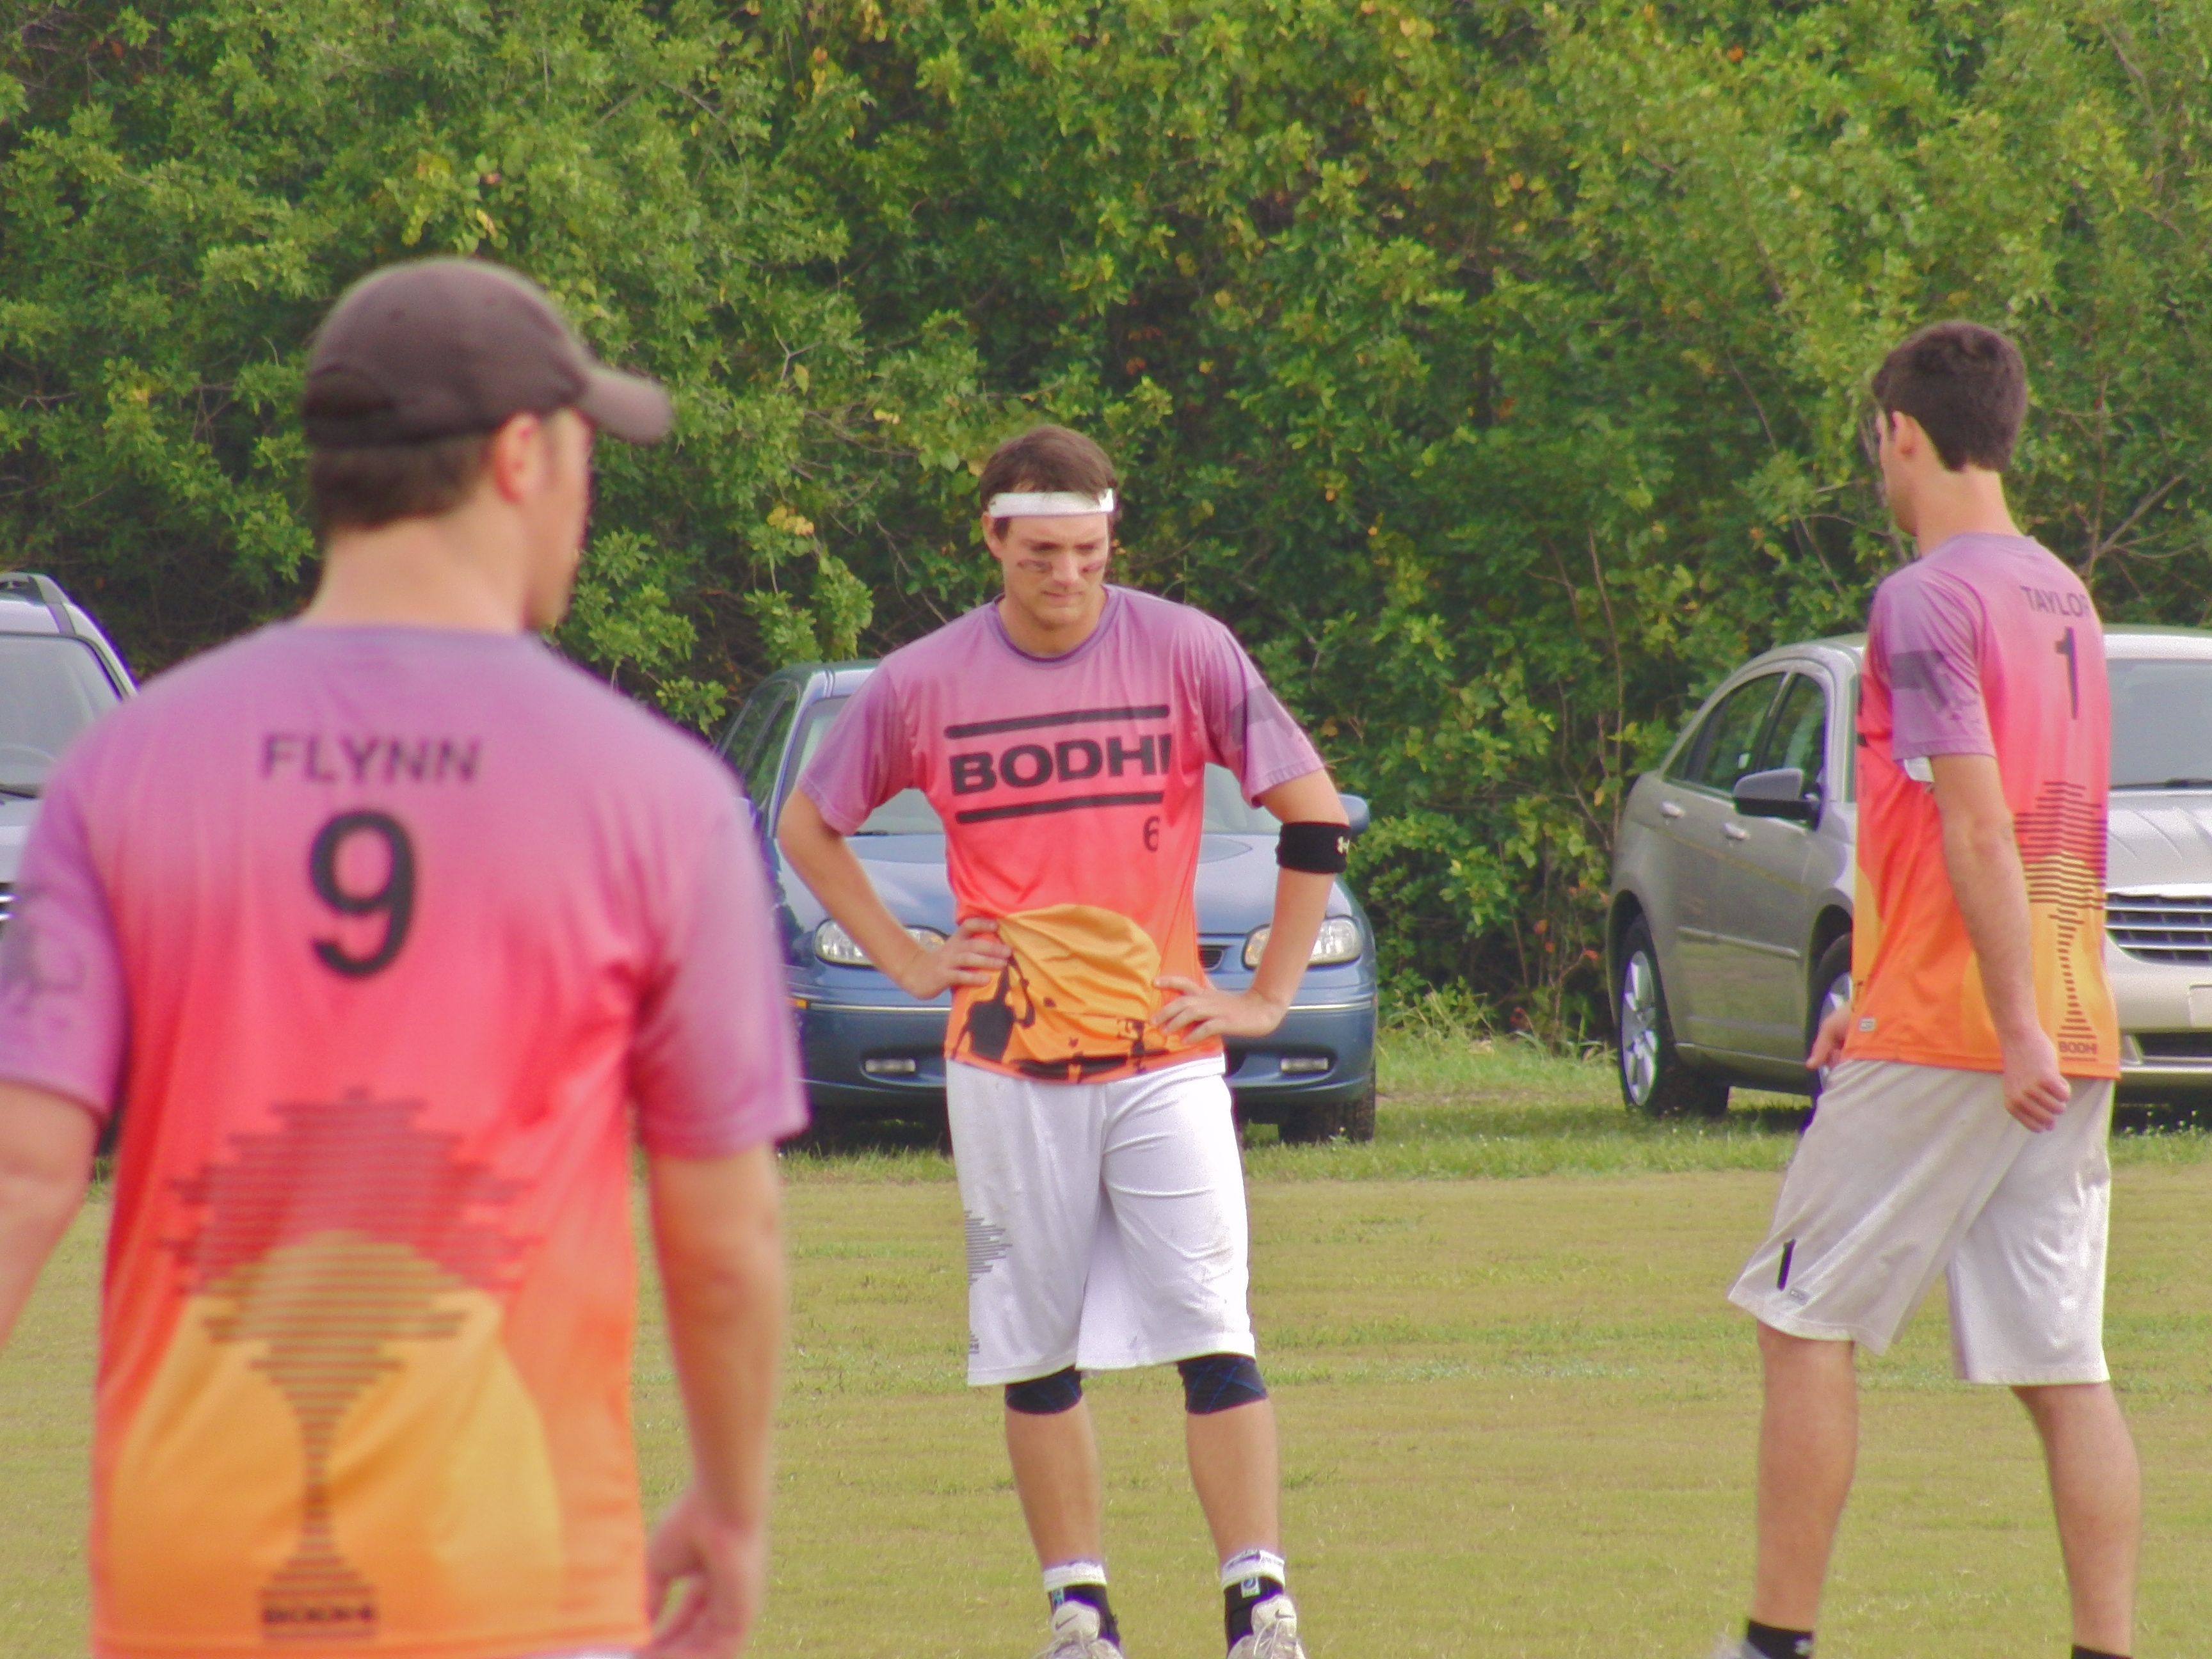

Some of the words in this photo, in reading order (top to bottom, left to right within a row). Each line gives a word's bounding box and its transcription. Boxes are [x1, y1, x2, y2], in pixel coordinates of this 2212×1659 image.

[2054, 627, 2079, 720] 1
[261, 732, 481, 783] FLYNN
[949, 733, 1172, 796] BODHI
[1143, 815, 1160, 853] 6
[309, 806, 416, 982] 9
